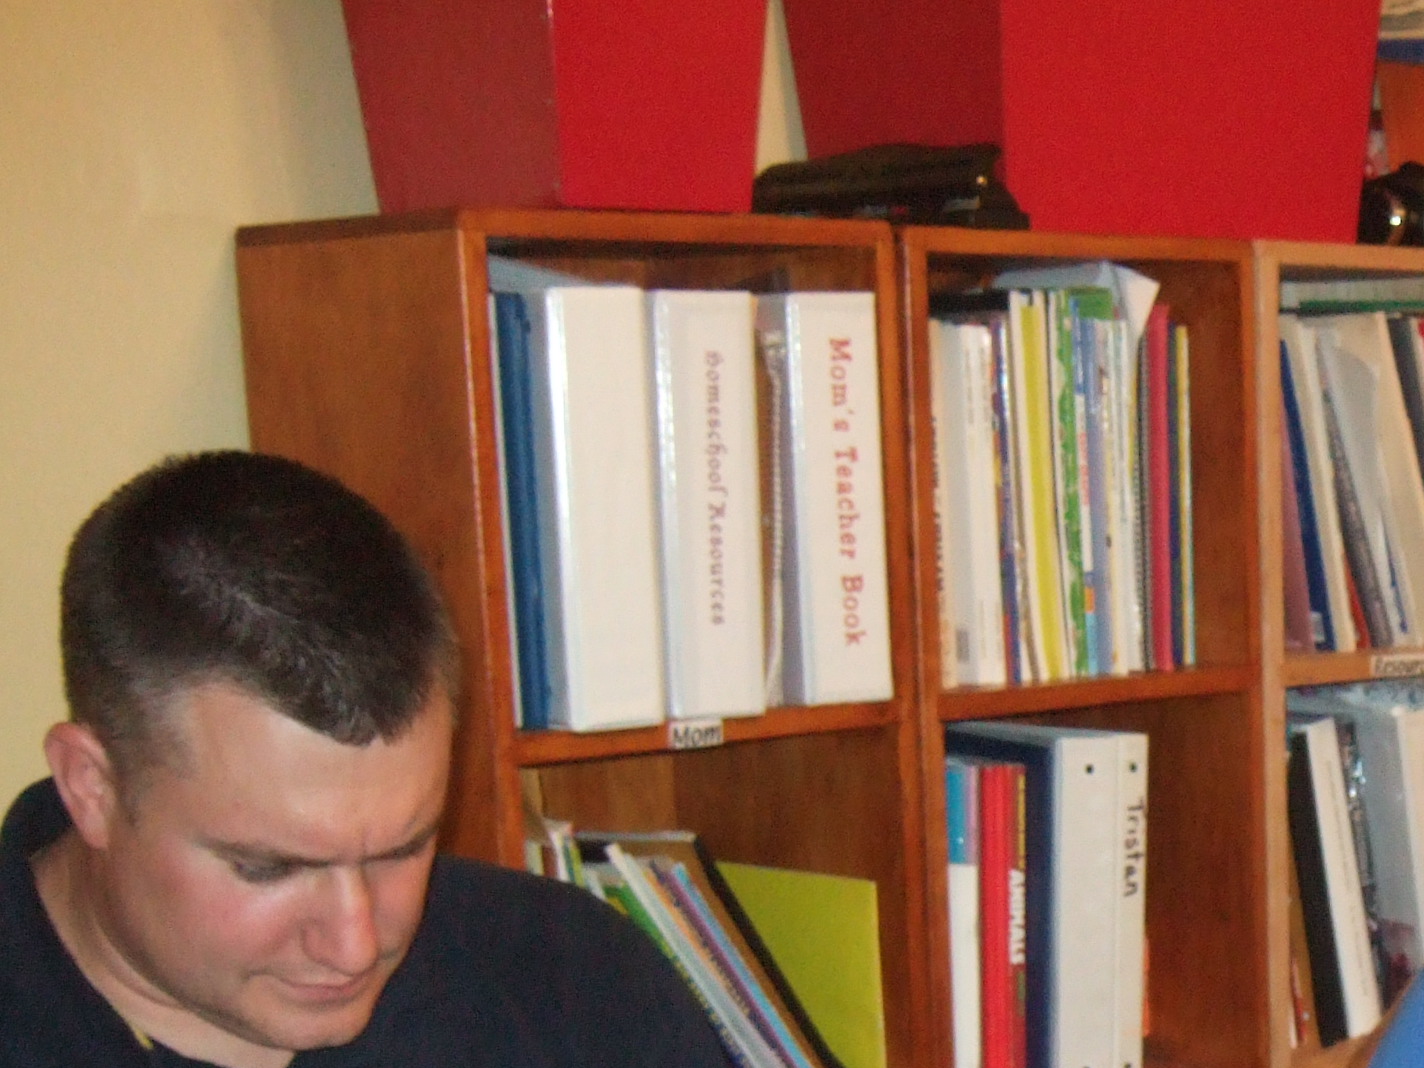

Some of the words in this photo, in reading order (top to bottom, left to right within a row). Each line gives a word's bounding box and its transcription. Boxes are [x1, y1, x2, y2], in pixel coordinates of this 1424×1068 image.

[705, 350, 729, 497] Homeschool
[829, 338, 856, 433] Mom's
[835, 447, 861, 560] Teacher
[708, 502, 728, 626] Resources
[842, 575, 869, 647] Book
[673, 726, 721, 747] Mom
[1122, 797, 1147, 897] Tristan
